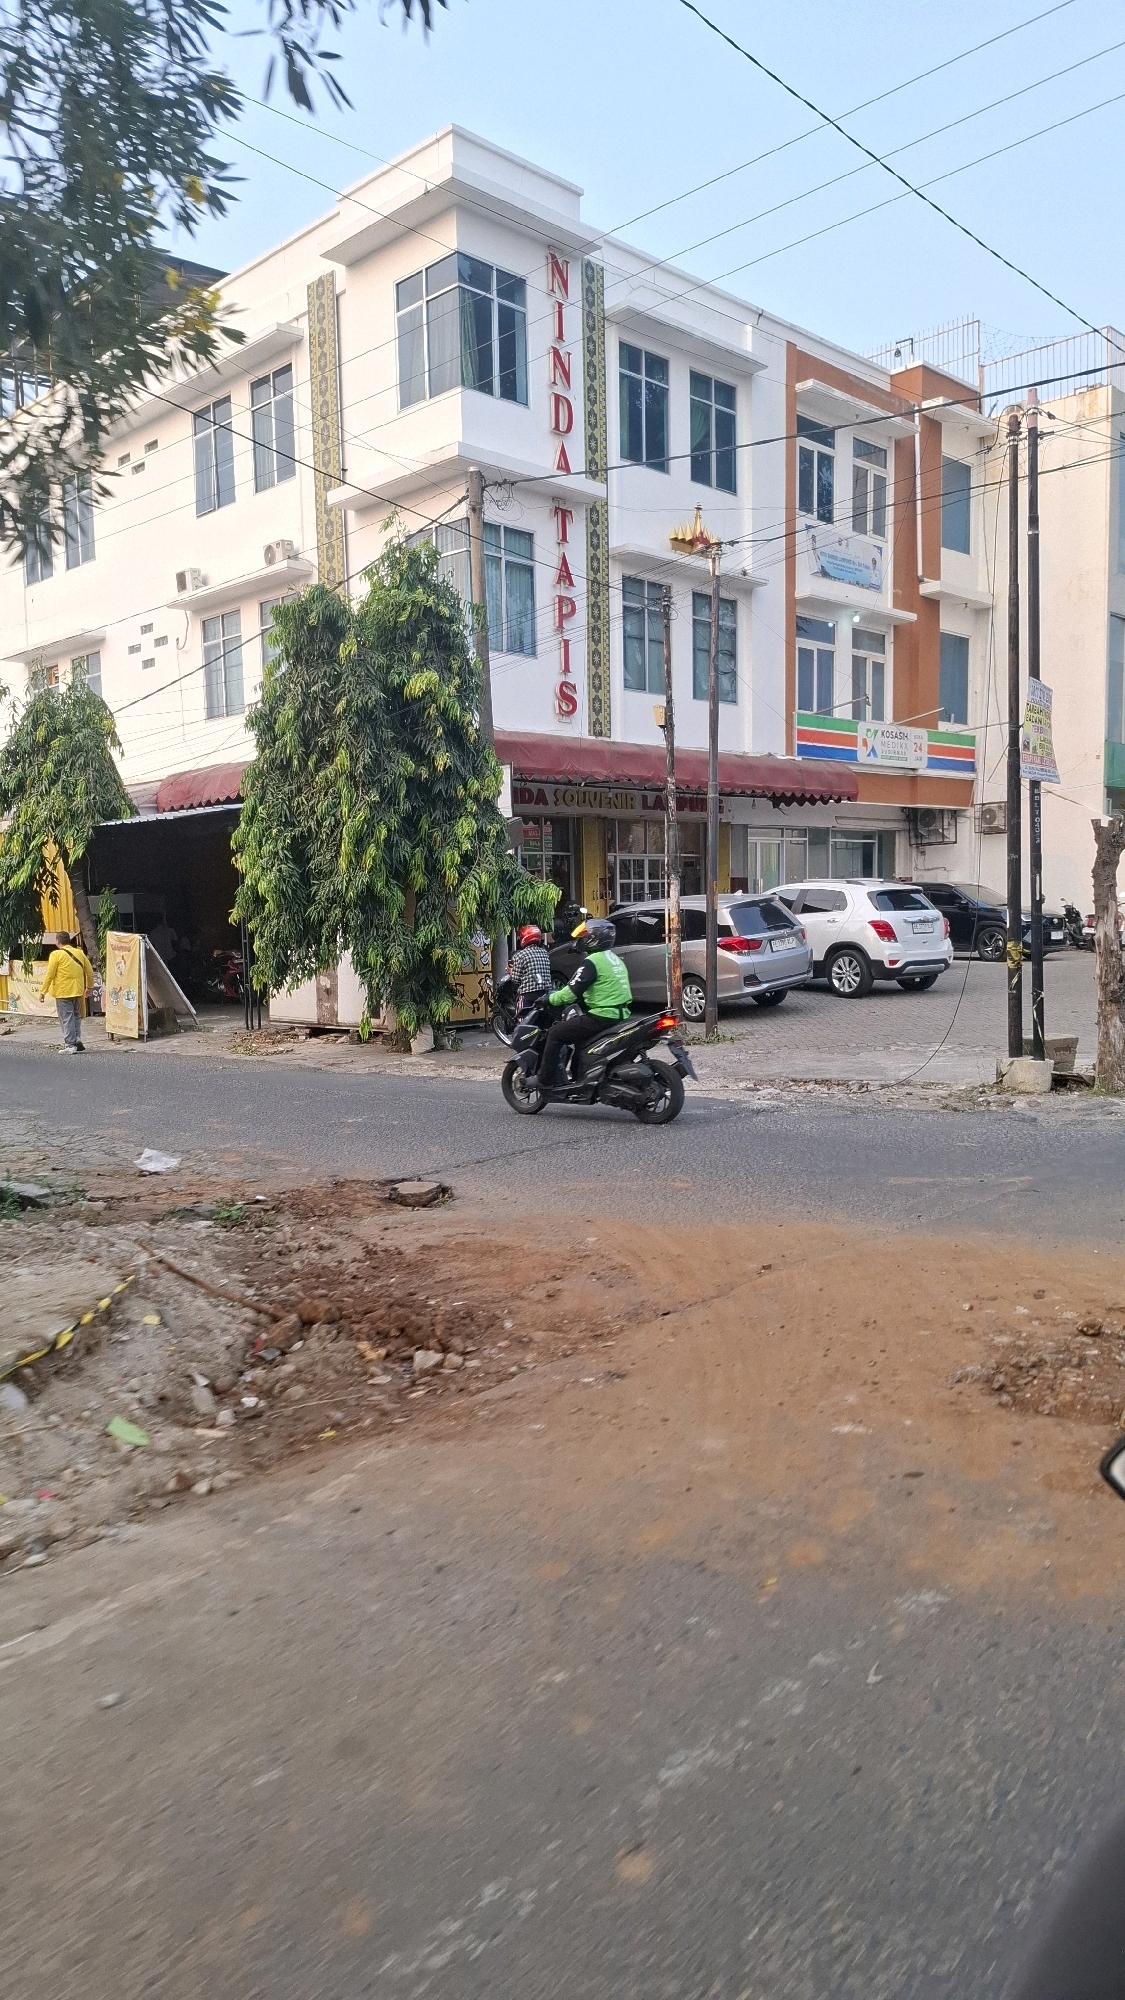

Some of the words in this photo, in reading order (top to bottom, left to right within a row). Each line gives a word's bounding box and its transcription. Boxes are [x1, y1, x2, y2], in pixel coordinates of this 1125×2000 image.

[548, 250, 573, 476] NINDA
[553, 503, 578, 717] TAPIS
[881, 730, 909, 741] KOSASIH
[881, 740, 908, 750] MEDIKA
[913, 742, 923, 753] 24
[554, 788, 636, 809] SOUVENIR
